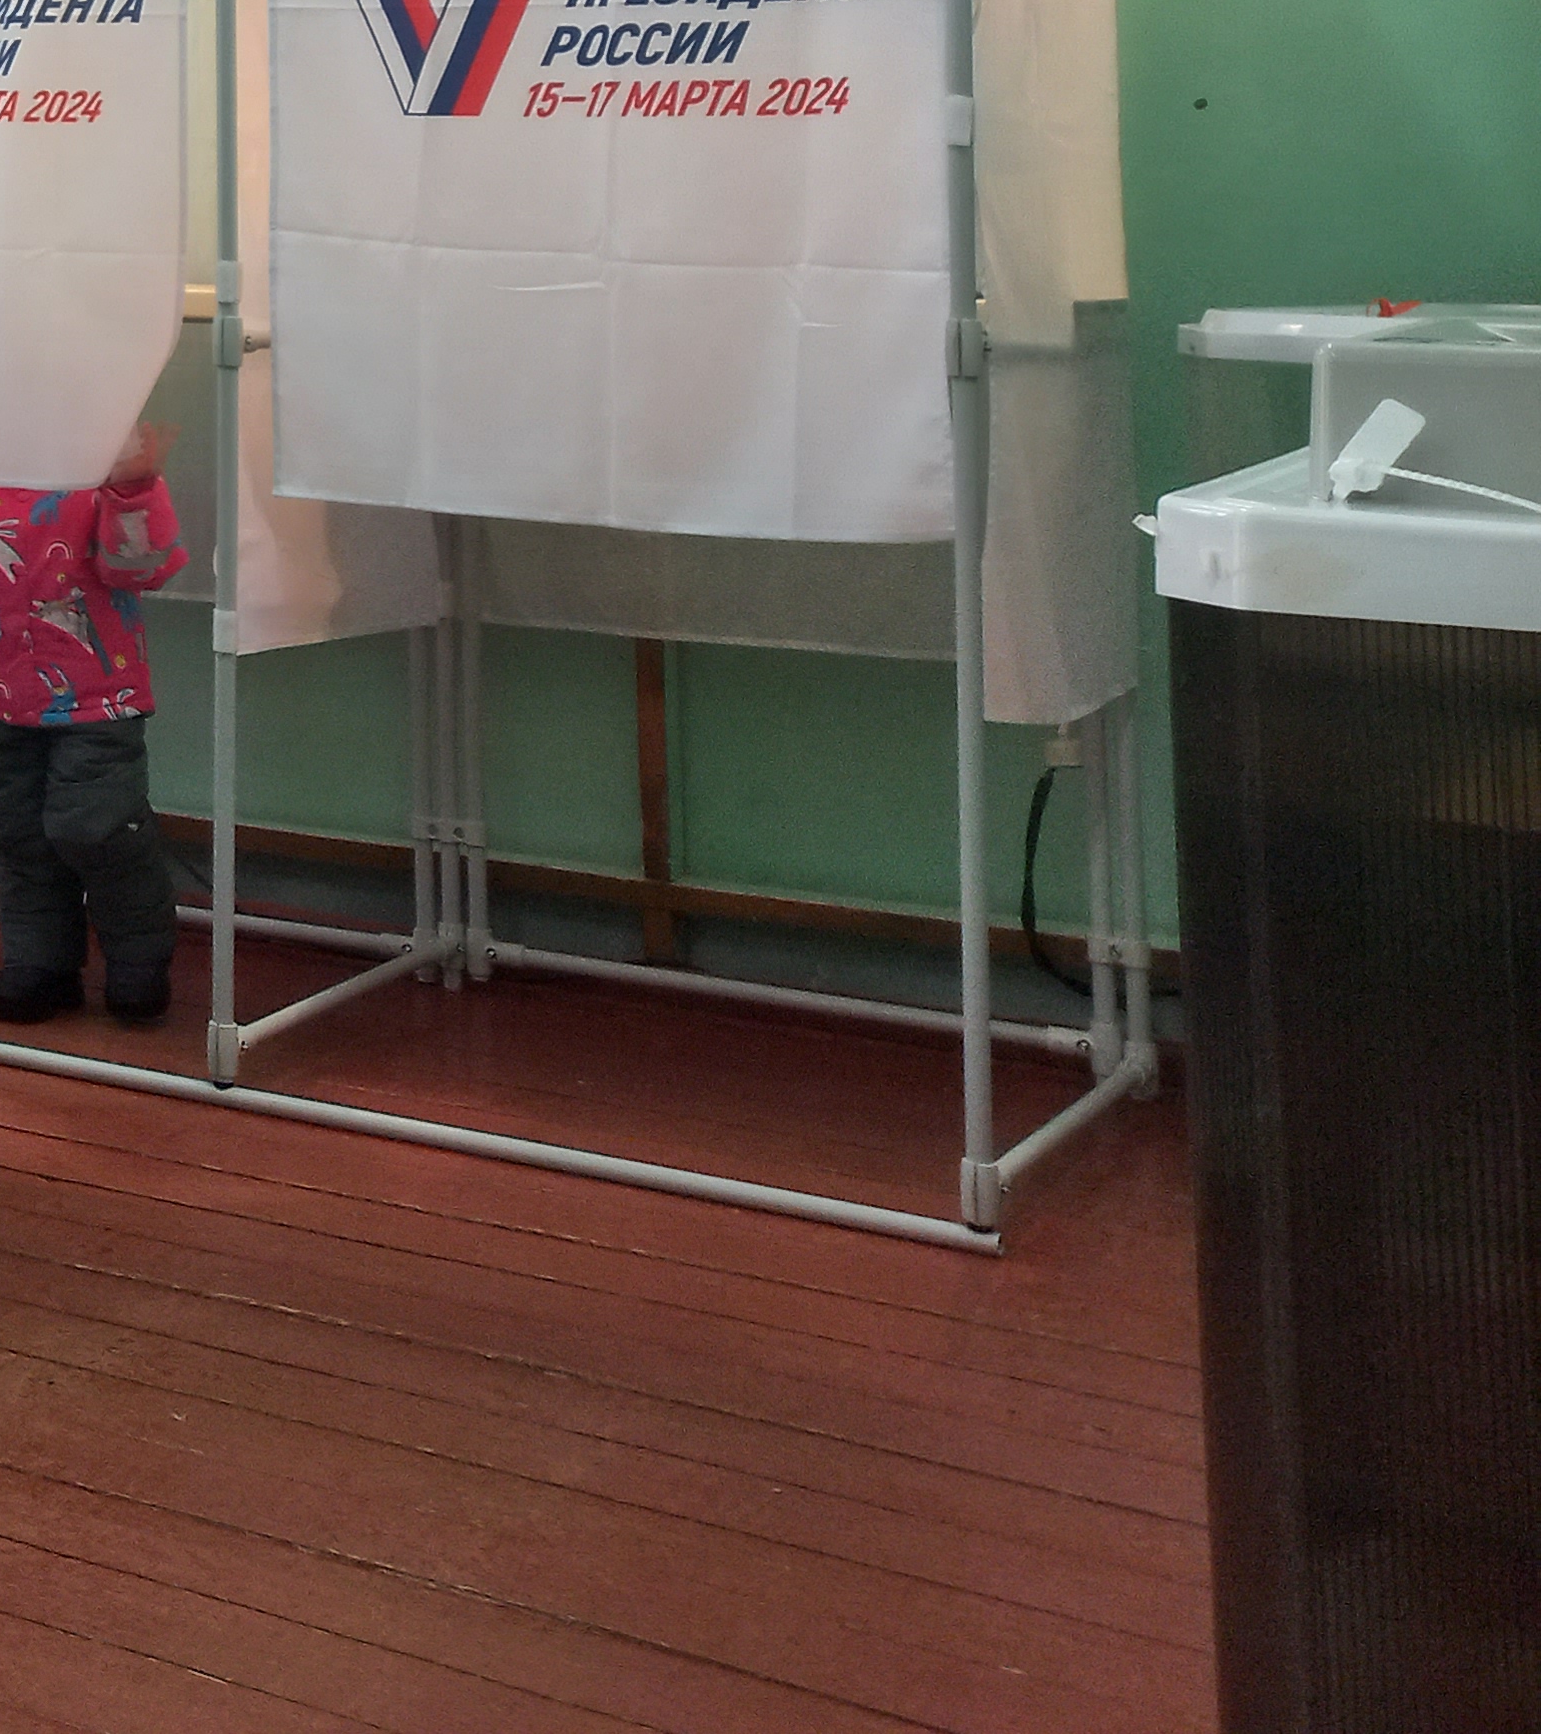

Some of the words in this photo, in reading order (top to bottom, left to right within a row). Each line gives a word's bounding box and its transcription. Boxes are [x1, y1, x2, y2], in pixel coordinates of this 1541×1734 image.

[540, 20, 750, 67] РОССИИ
[23, 91, 104, 123] 2024
[621, 79, 749, 119] МАРТА
[756, 76, 851, 118] 2024
